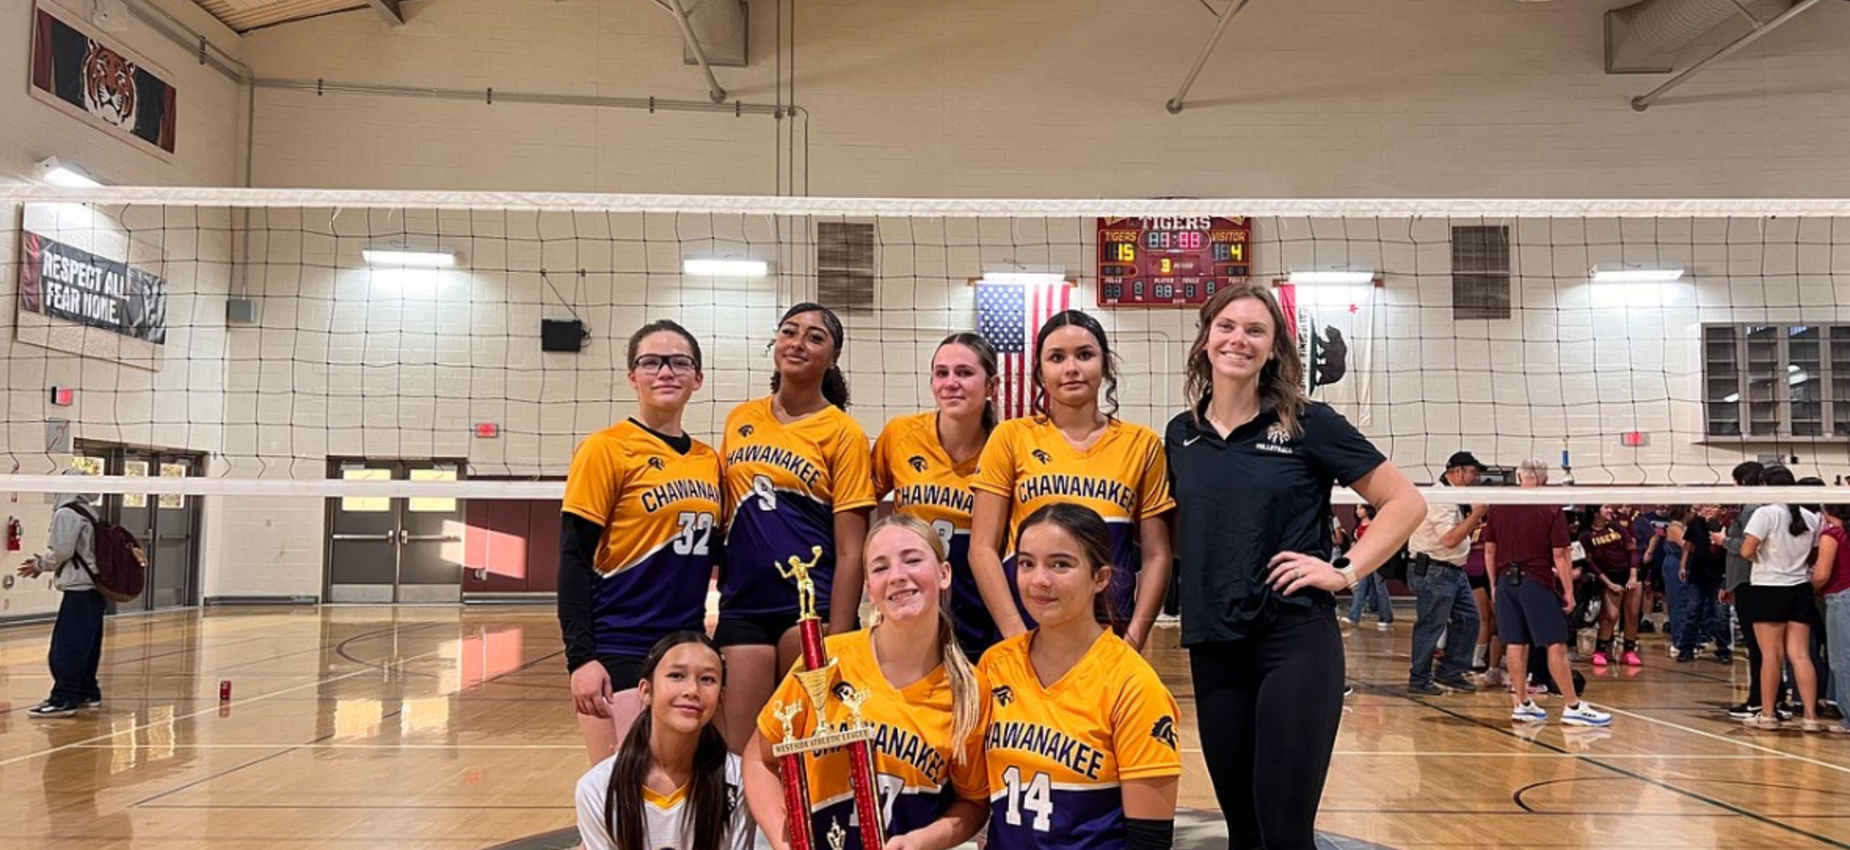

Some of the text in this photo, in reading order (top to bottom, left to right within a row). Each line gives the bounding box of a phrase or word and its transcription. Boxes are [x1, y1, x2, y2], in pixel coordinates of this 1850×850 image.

[1105, 231, 1137, 243] TIGERS
[1138, 215, 1211, 230] TIGERS
[1211, 231, 1246, 243] VISITOR
[42, 250, 103, 291] RESPECT
[1160, 258, 1171, 273] 3
[1231, 243, 1242, 261] 4
[46, 280, 120, 324] FEAR NONE.
[753, 474, 777, 511] 9
[1018, 474, 1138, 515] CHAWANAKEE
[673, 511, 715, 556] 32
[848, 773, 905, 832] 7
[1001, 764, 1054, 832] 14
